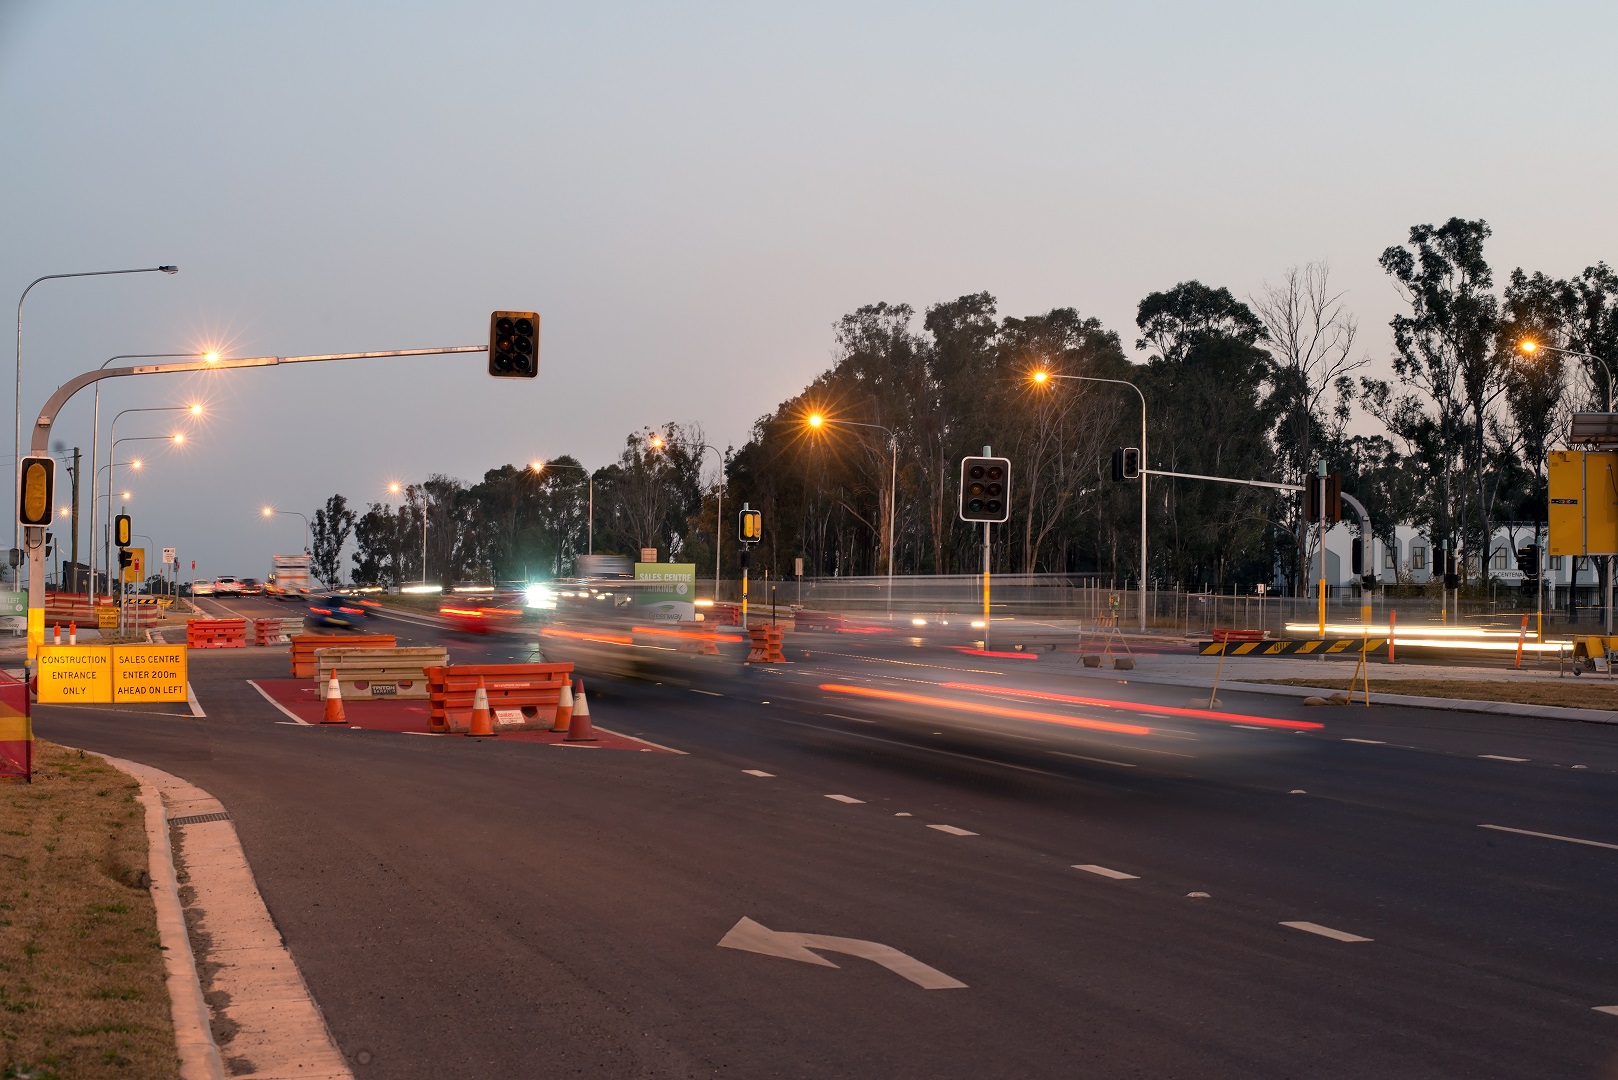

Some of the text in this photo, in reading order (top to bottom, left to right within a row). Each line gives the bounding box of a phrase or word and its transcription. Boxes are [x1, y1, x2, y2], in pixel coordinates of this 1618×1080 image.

[640, 573, 691, 582] SALES CENTRE
[649, 612, 682, 622] Greenway
[41, 655, 107, 664] CONSTRUCTION
[118, 655, 181, 664] SALES CENTRE
[52, 671, 97, 680] ENTRANCE
[122, 670, 177, 679] ENTER 200m
[62, 687, 87, 695] ONLY
[117, 686, 183, 695] AHEAD ON LEFT
